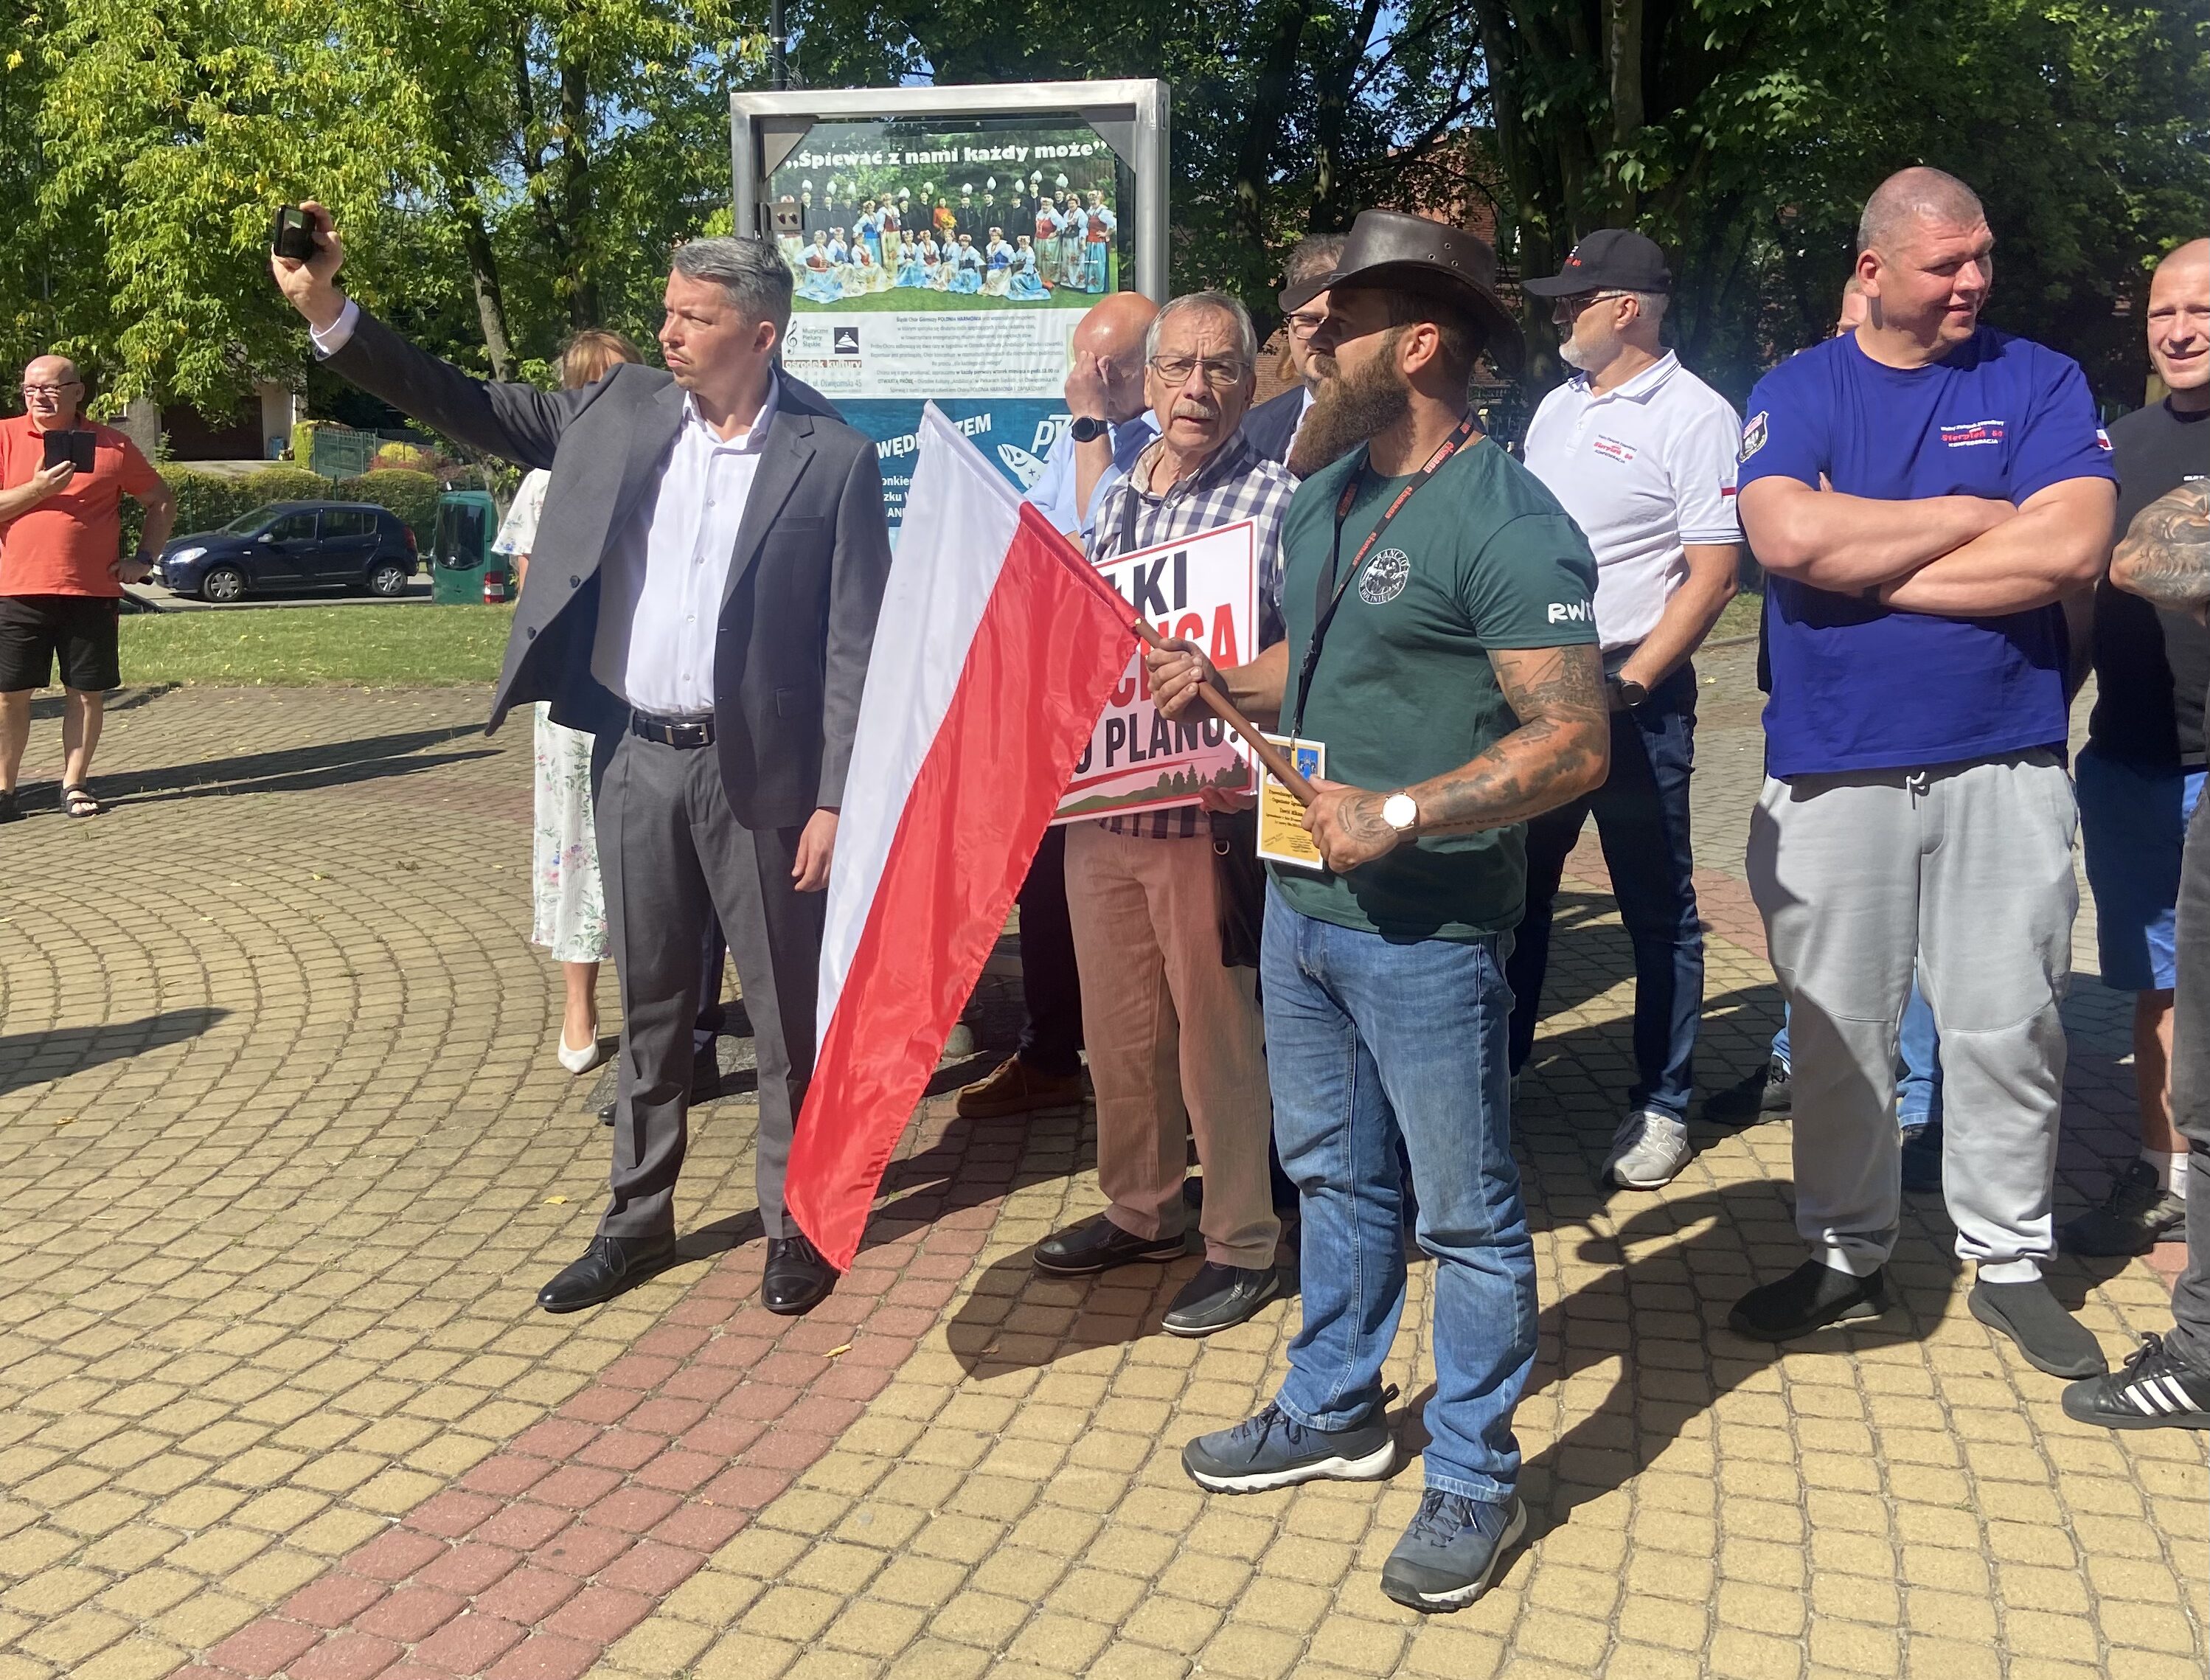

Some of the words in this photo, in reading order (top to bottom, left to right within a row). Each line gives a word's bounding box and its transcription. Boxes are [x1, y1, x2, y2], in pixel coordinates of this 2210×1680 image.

[888, 152, 900, 164] z
[905, 146, 959, 164] nami
[964, 145, 1029, 162] każdy
[855, 379, 862, 387] 45
